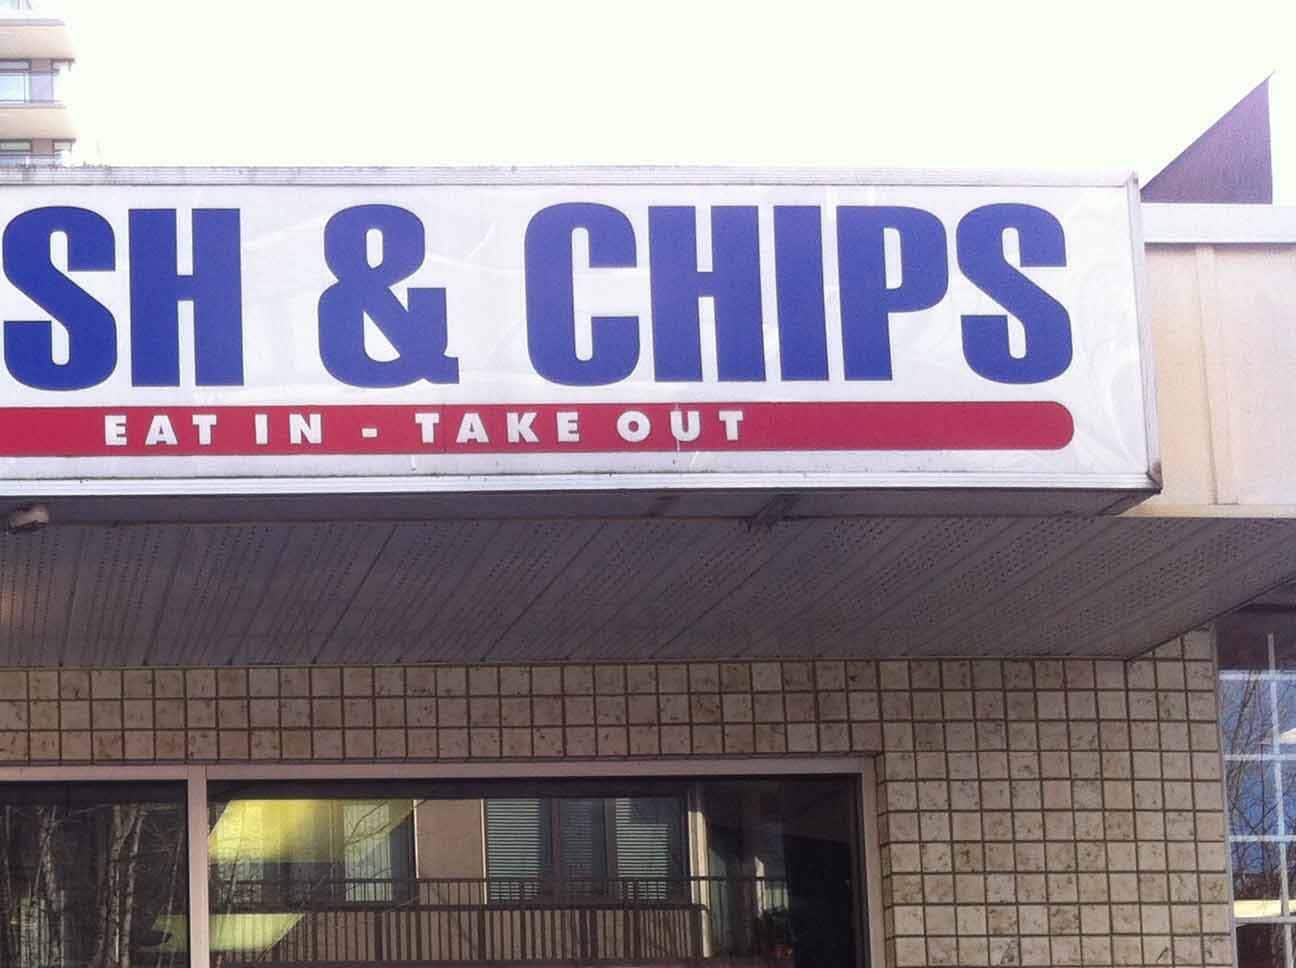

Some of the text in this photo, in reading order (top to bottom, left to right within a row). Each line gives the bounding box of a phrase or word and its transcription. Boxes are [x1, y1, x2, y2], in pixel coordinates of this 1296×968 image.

[318, 204, 460, 387] &
[524, 202, 1073, 384] CHIPS
[104, 414, 218, 446] EAT
[254, 413, 322, 444] IN
[415, 411, 580, 444] TAKE
[616, 410, 745, 443] OUT
